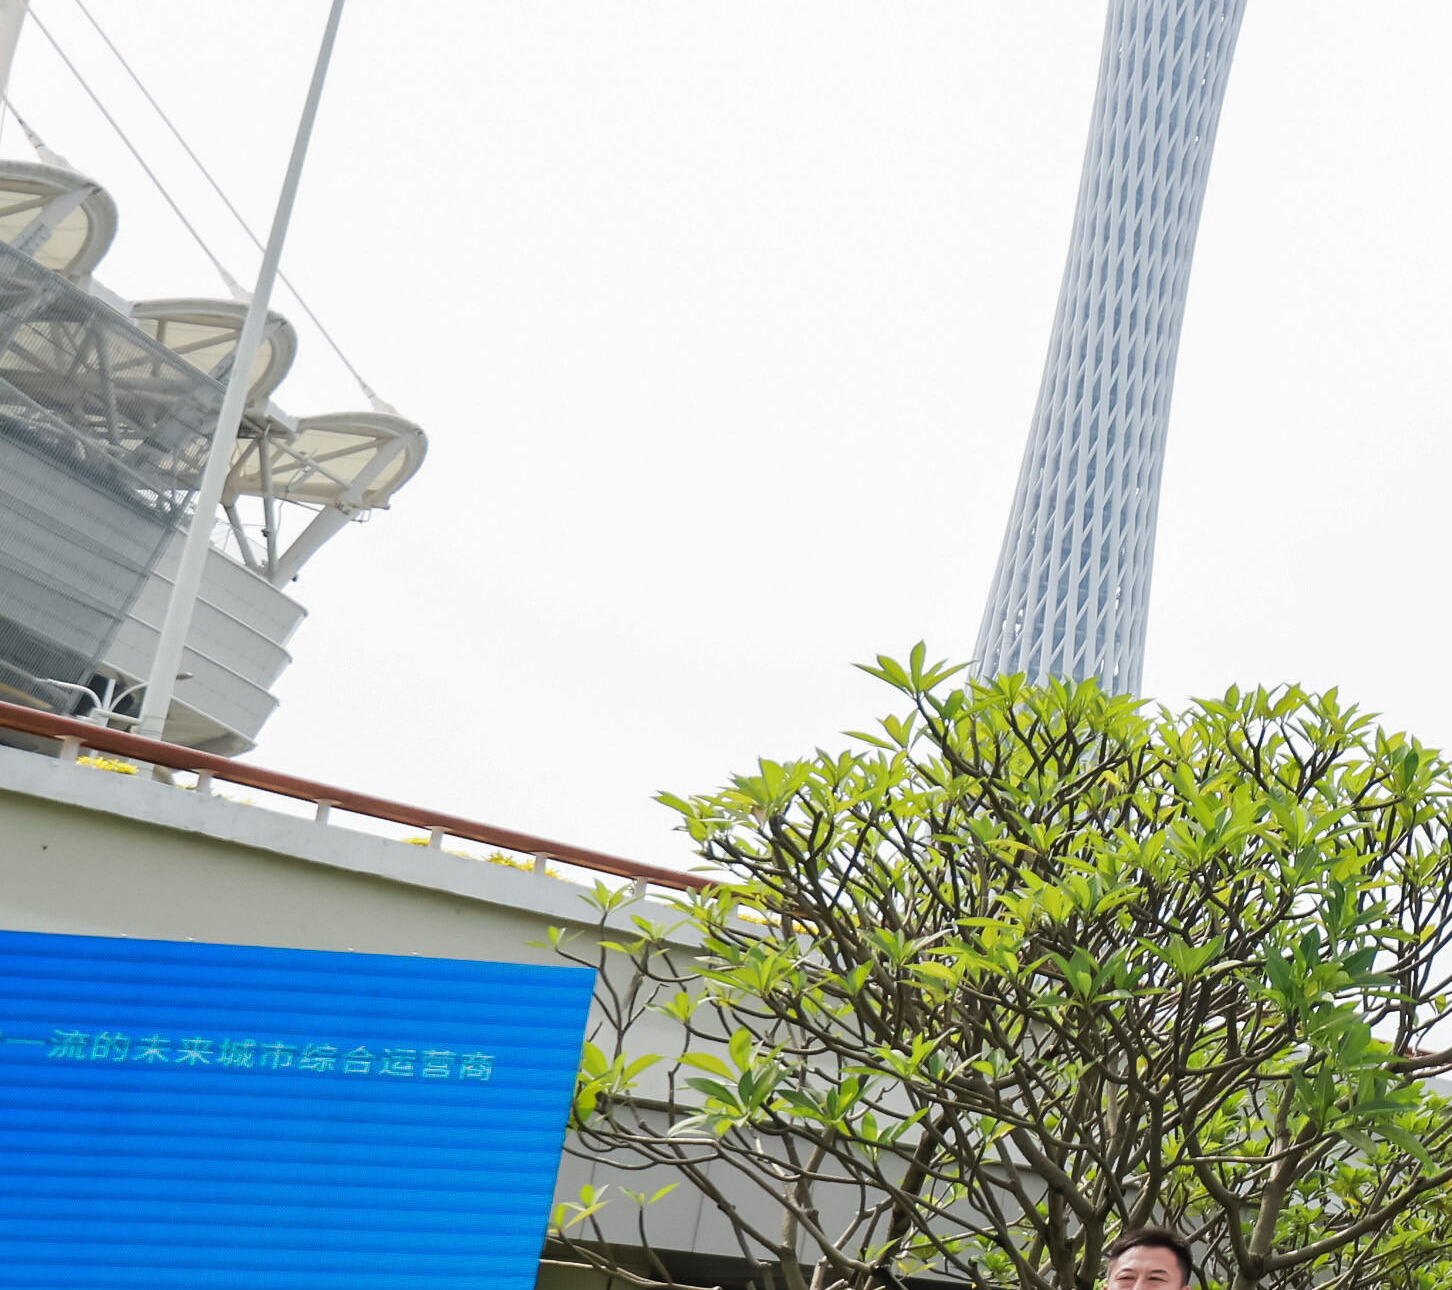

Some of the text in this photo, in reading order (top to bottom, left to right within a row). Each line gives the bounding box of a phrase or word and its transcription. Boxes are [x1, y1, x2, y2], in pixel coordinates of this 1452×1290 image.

[5, 1028, 495, 1082] 一流的未来城市综合运营商
